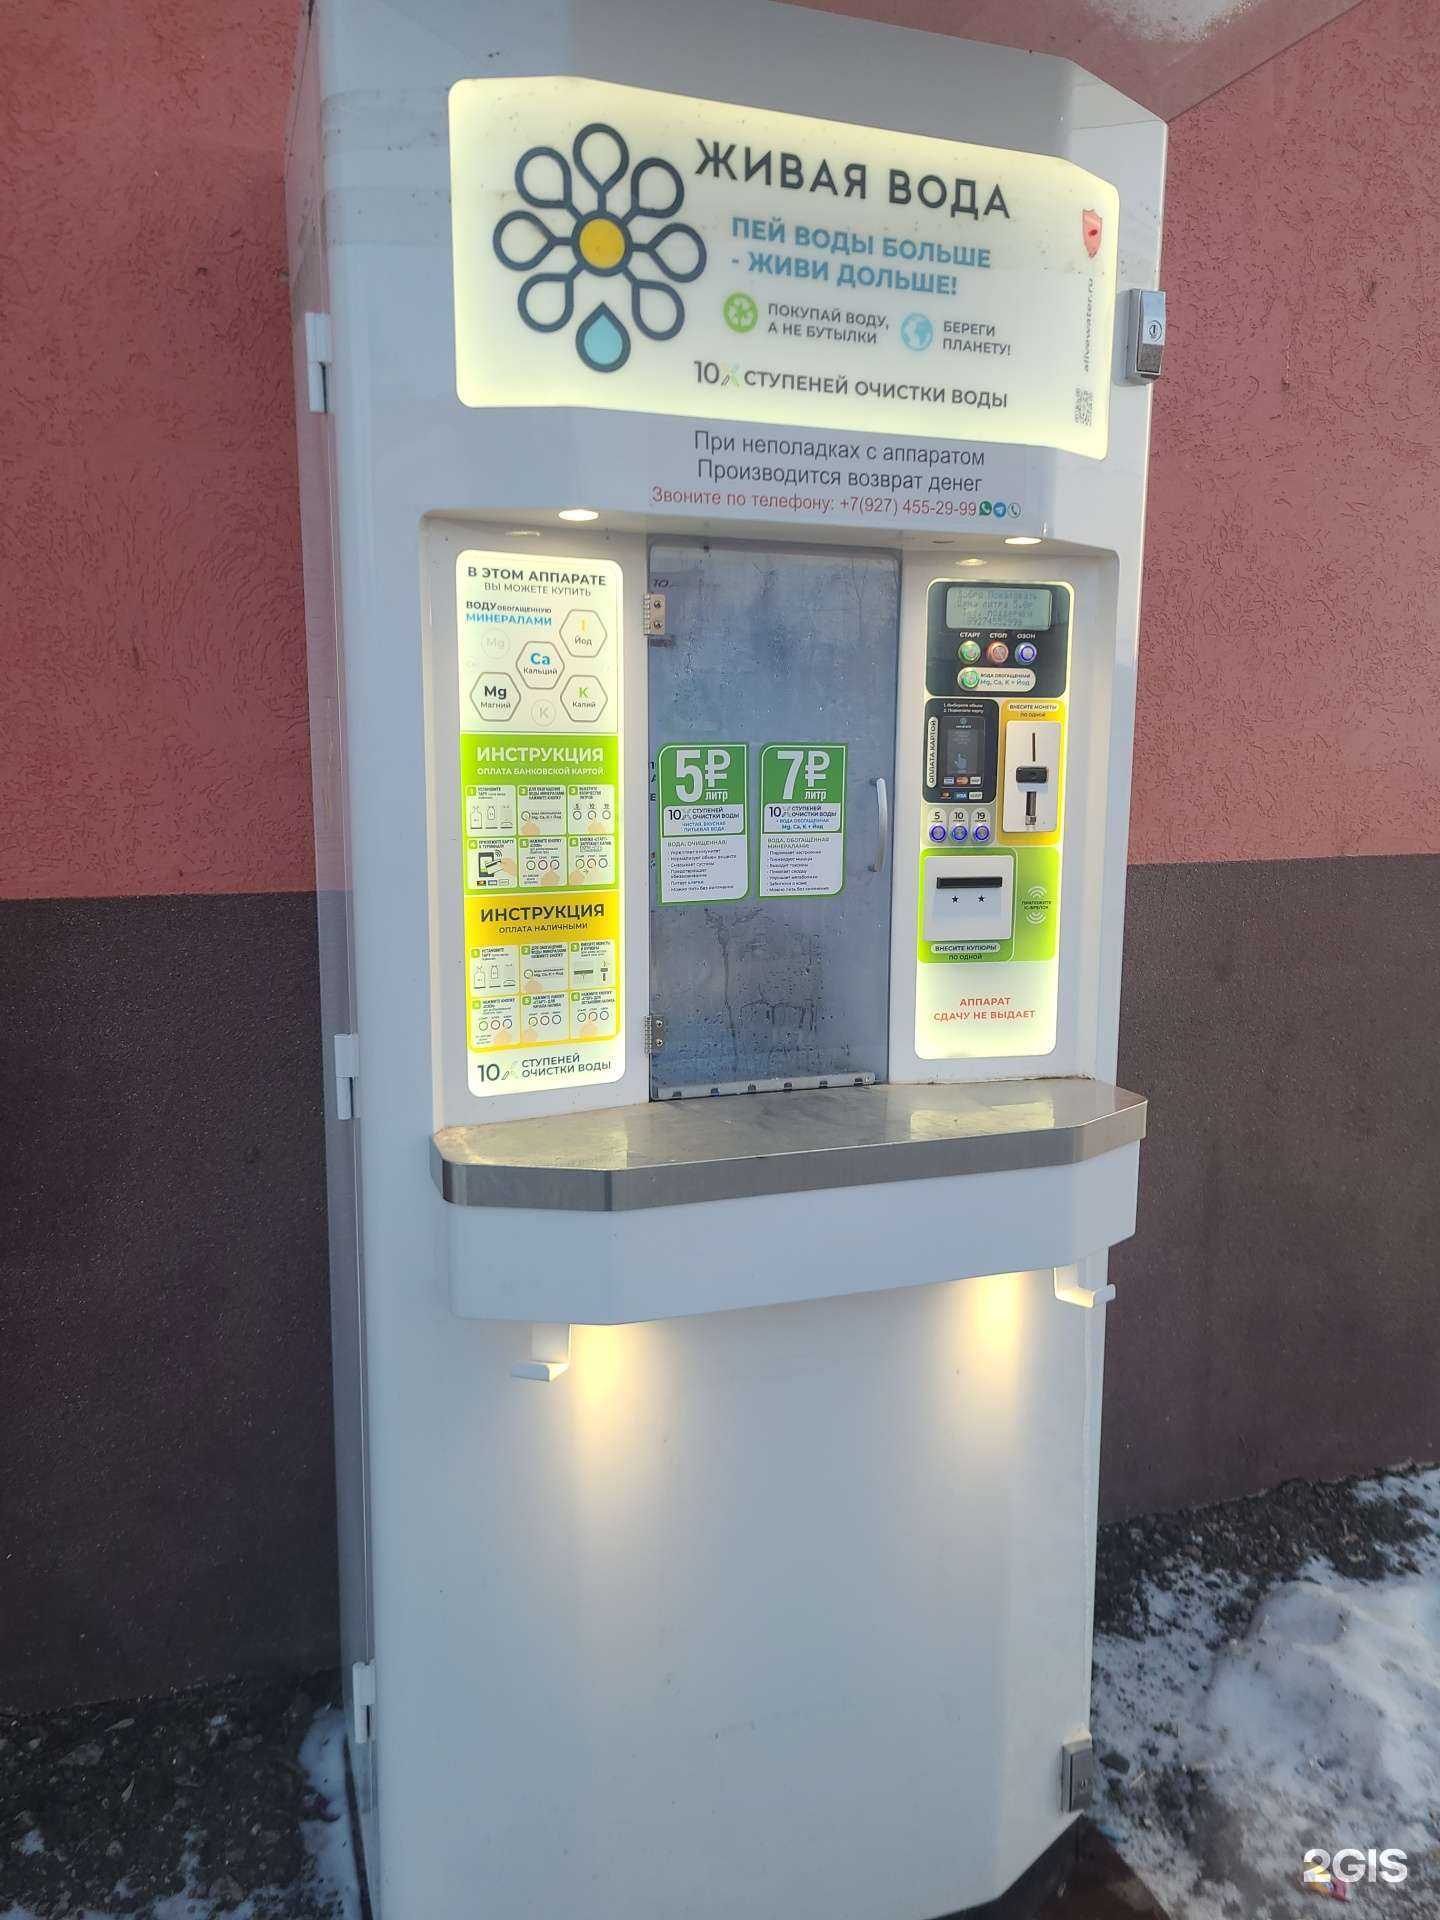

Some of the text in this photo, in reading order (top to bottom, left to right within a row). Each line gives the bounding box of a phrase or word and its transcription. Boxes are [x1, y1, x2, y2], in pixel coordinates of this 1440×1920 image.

[695, 138, 1010, 221] ЖИВАЯ ВОДА
[732, 216, 991, 268] ПЕЙ ВОДЫ БОЛЬШЕ
[748, 252, 829, 281] ЖИВИ
[837, 264, 957, 296] ДОЛЬШЕ!
[768, 303, 889, 330] ПОКУПАЙ ВОДУ,
[768, 324, 877, 345] А НЕ БУТЫЛКИ
[943, 321, 995, 337] БЕРЕГИ
[942, 339, 1011, 356] ПЛАНЕТУ!
[693, 360, 1007, 408] 10 СТУПЕНЕЙ ОЧИСТКИ ВОДЫ
[695, 430, 985, 466] При неполадках с аппаратом
[698, 459, 984, 495] Производится возврат денег
[651, 486, 977, 517] Звоните по телефону: +7(927) 455-29-99
[468, 566, 606, 586] В ЭТОМ АППАРАТЕ
[484, 582, 591, 597] ВЫ МОЖЕТЕ КУПИТЬ
[466, 601, 497, 611] ВОДУ
[466, 613, 552, 626] МИНЕРАЛАМИ
[575, 635, 592, 646] Йод
[530, 653, 551, 665] Ca
[524, 667, 557, 675] Кальций
[484, 686, 507, 699] Mg
[579, 688, 588, 698] K
[477, 747, 604, 764] ИНСТРУКЦИЯ
[477, 767, 603, 776] ОПЛАТА БАНКОВСКОЙ КАРТОЙ
[668, 809, 681, 821] 10
[769, 806, 781, 817] 10
[481, 904, 605, 922] ИНСТРУКЦИЯ
[499, 923, 588, 934] ОПЛАТА НАЛИЧНЫМИ
[960, 998, 1010, 1006] АППАРАТ
[934, 1010, 1035, 1022] СДАЧУ НЕ ВЫДАЕТ
[477, 1054, 580, 1082] 10 СТУПЕНЕЙ
[522, 1061, 611, 1078] ОЧИСТКИ ВОДЫ
